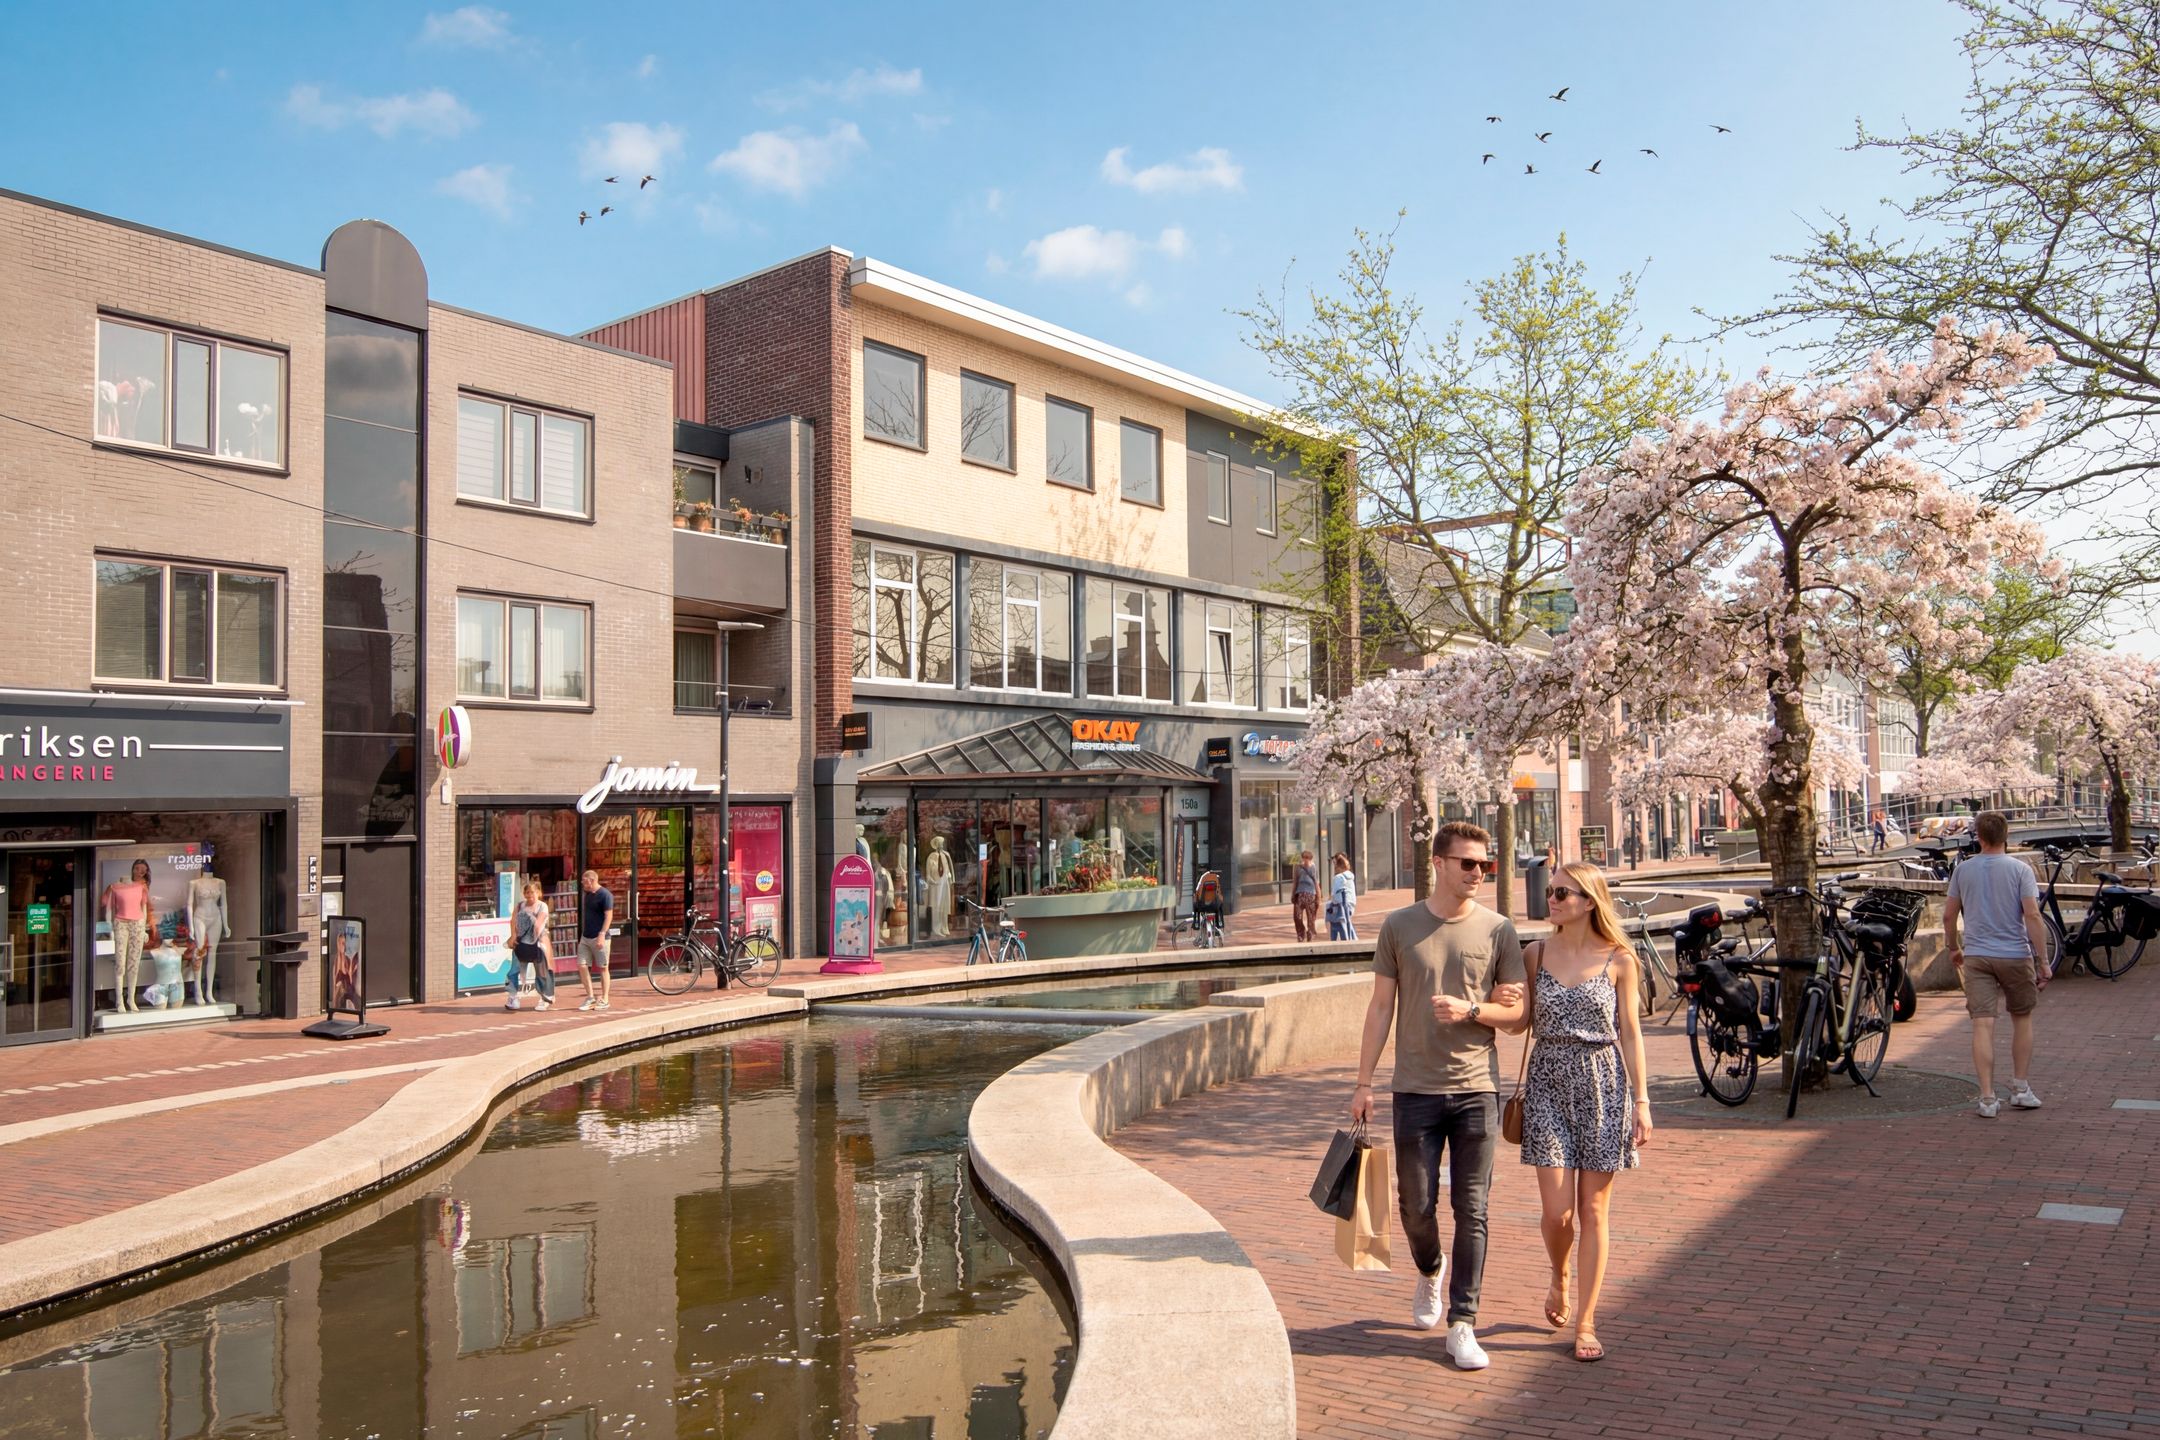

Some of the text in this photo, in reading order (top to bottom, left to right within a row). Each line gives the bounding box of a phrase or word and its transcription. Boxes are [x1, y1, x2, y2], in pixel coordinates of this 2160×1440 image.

[0, 725, 142, 758] riksen
[1072, 719, 1140, 742] OKAY
[576, 755, 720, 814] jamin
[1180, 798, 1199, 810] 150a
